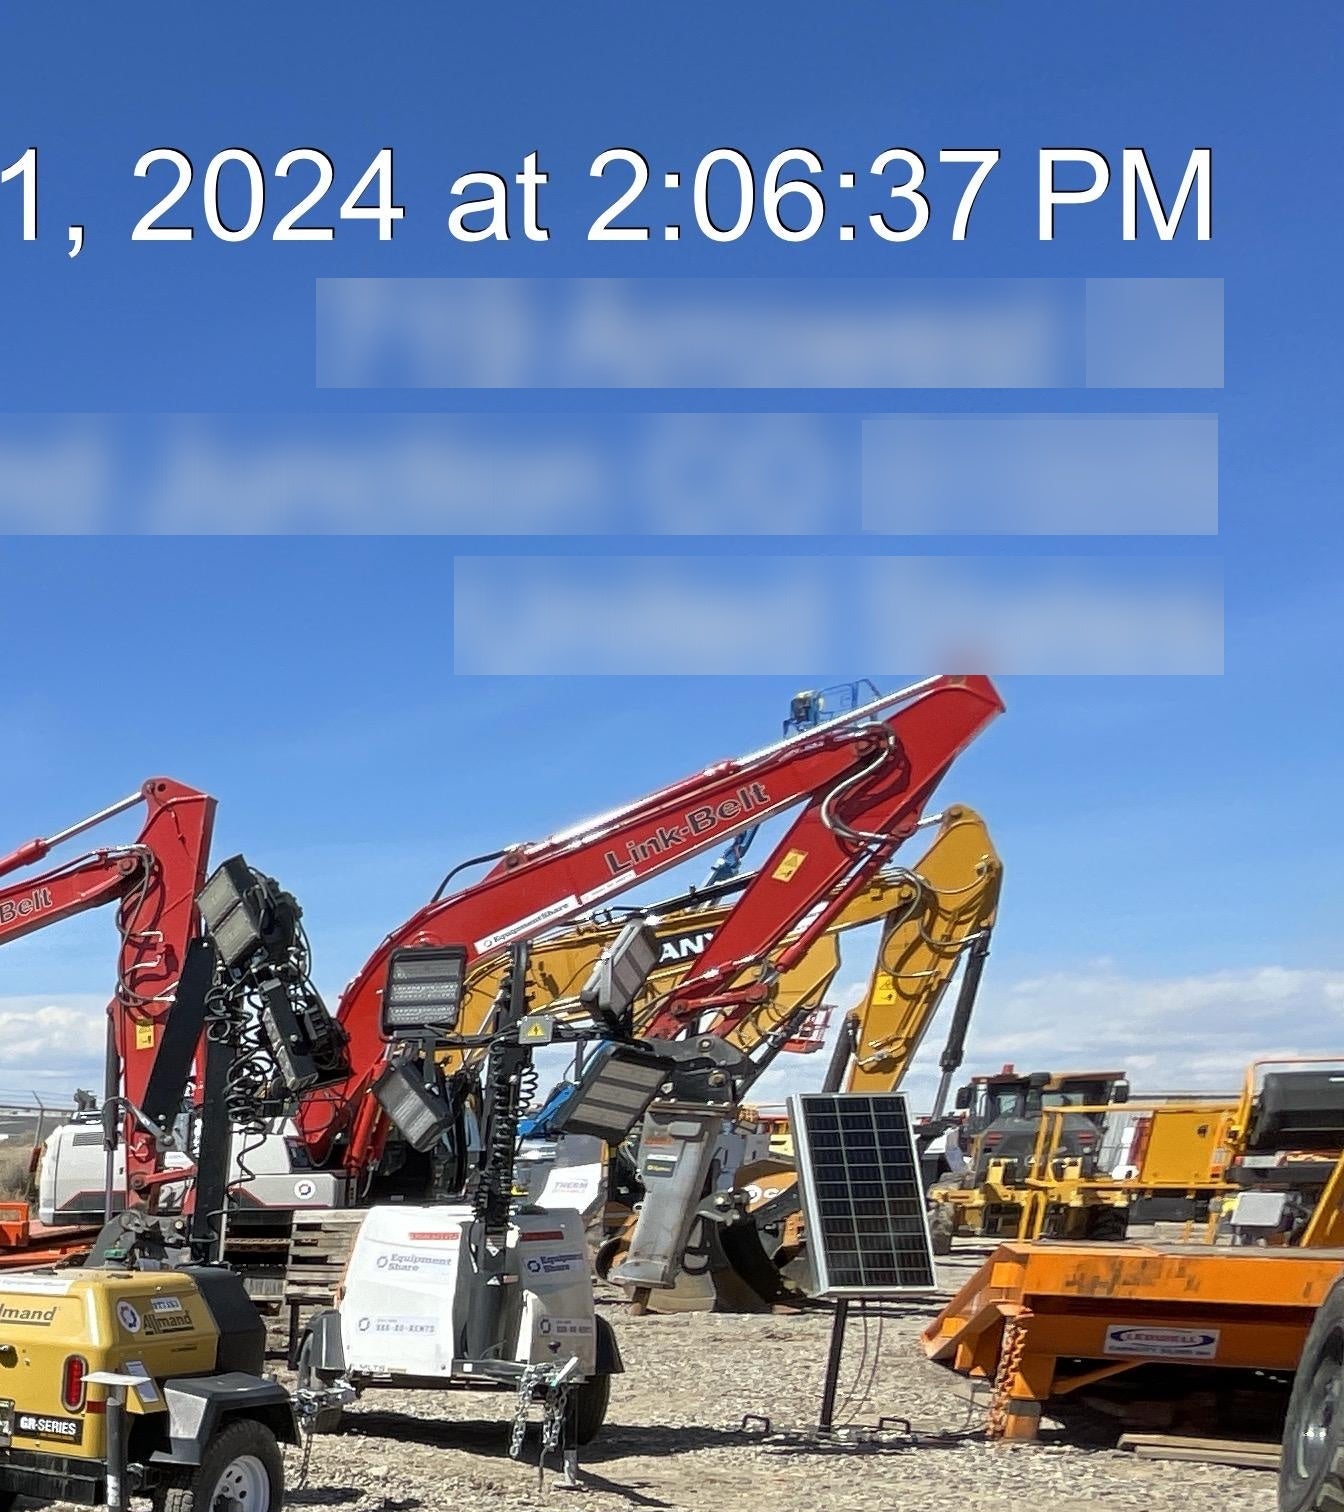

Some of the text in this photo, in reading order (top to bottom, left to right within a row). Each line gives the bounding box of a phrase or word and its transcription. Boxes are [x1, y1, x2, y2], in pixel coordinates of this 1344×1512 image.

[604, 781, 771, 875] Link-Belt
[143, 1310, 194, 1333] Allmand
[19, 1416, 77, 1435] GR-SERIES
